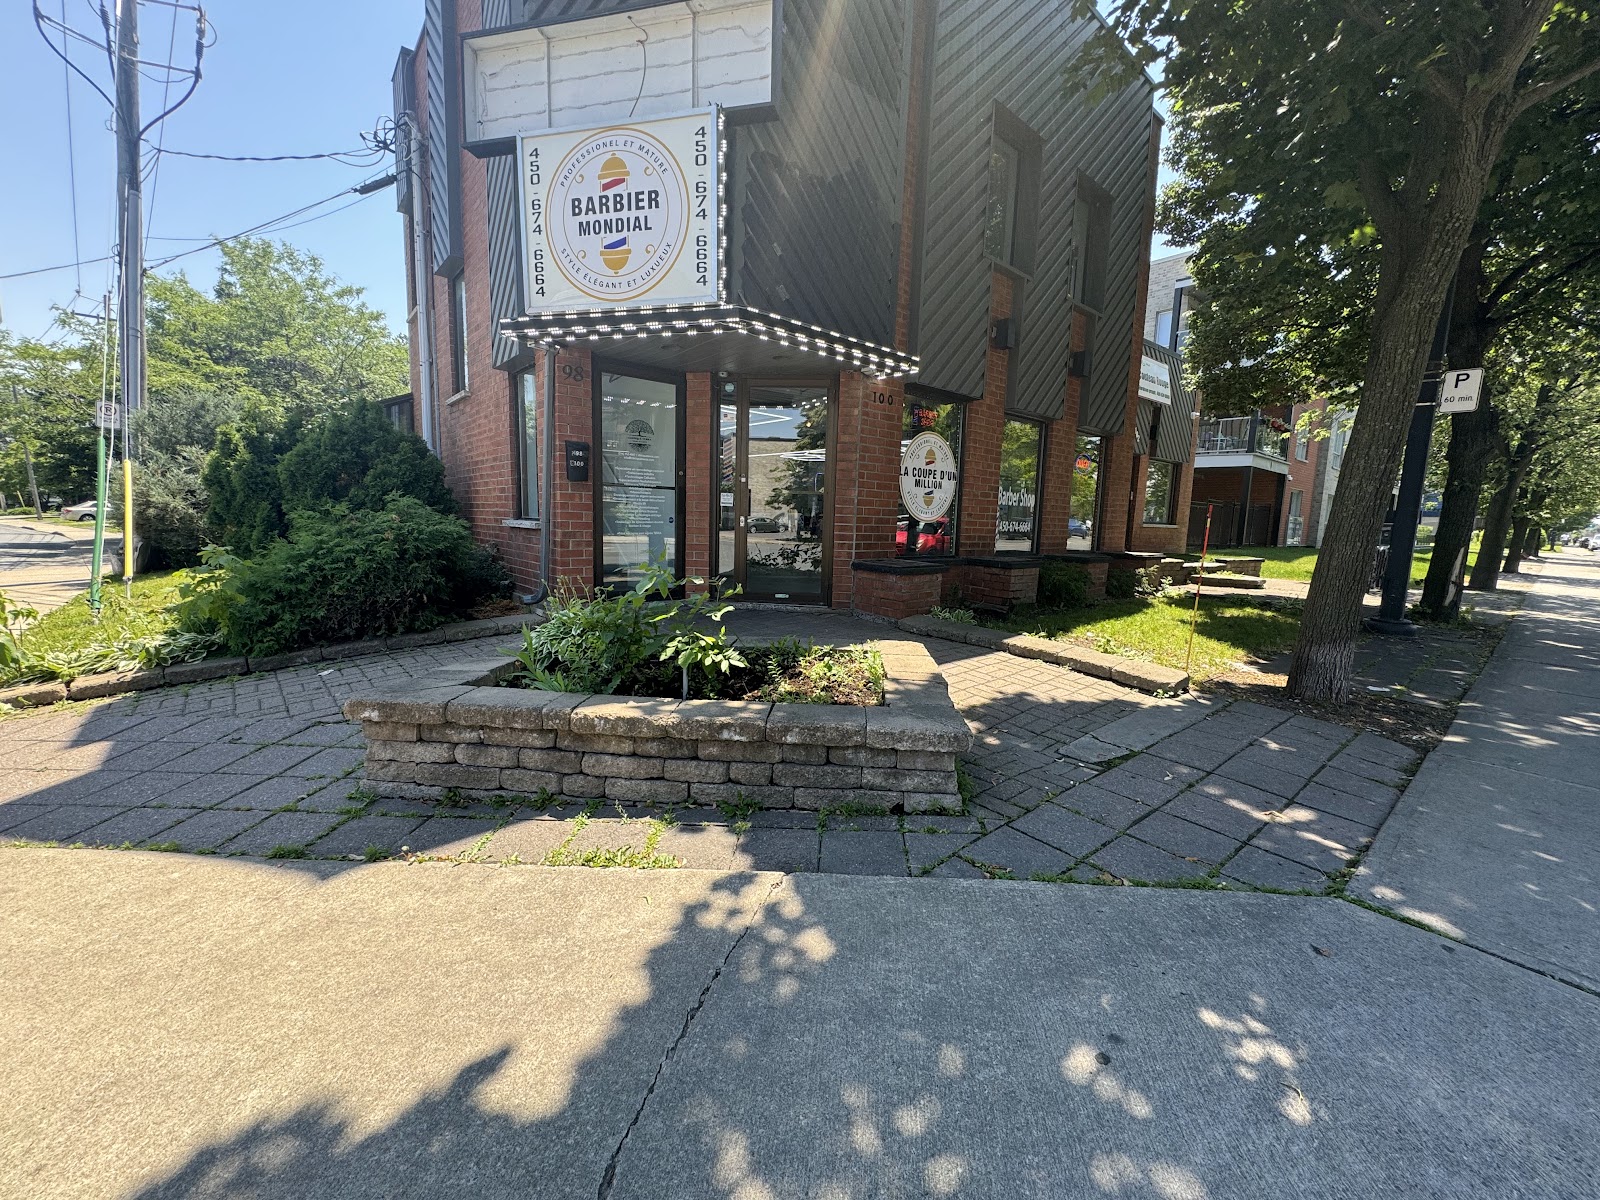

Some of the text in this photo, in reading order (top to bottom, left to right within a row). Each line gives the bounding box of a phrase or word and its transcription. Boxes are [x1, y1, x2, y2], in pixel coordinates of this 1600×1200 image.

[560, 139, 668, 187] PROFESSIONEL ET MATURE
[571, 189, 660, 217] BARBIER
[695, 126, 708, 286] 450-674-6664
[529, 147, 546, 297] 450-674-6664
[578, 215, 653, 237] MONDIAL
[561, 248, 581, 275] STYLE
[627, 279, 637, 288] ET
[640, 242, 672, 281] LUXUEUX
[562, 364, 584, 382] 98
[1454, 373, 1470, 388] P
[873, 392, 894, 406] 100
[900, 465, 957, 482] LA COUPE D'UN
[915, 479, 942, 490] MILLION
[998, 486, 1035, 512] Barber Shop
[999, 520, 1031, 532] 450-674-6664
